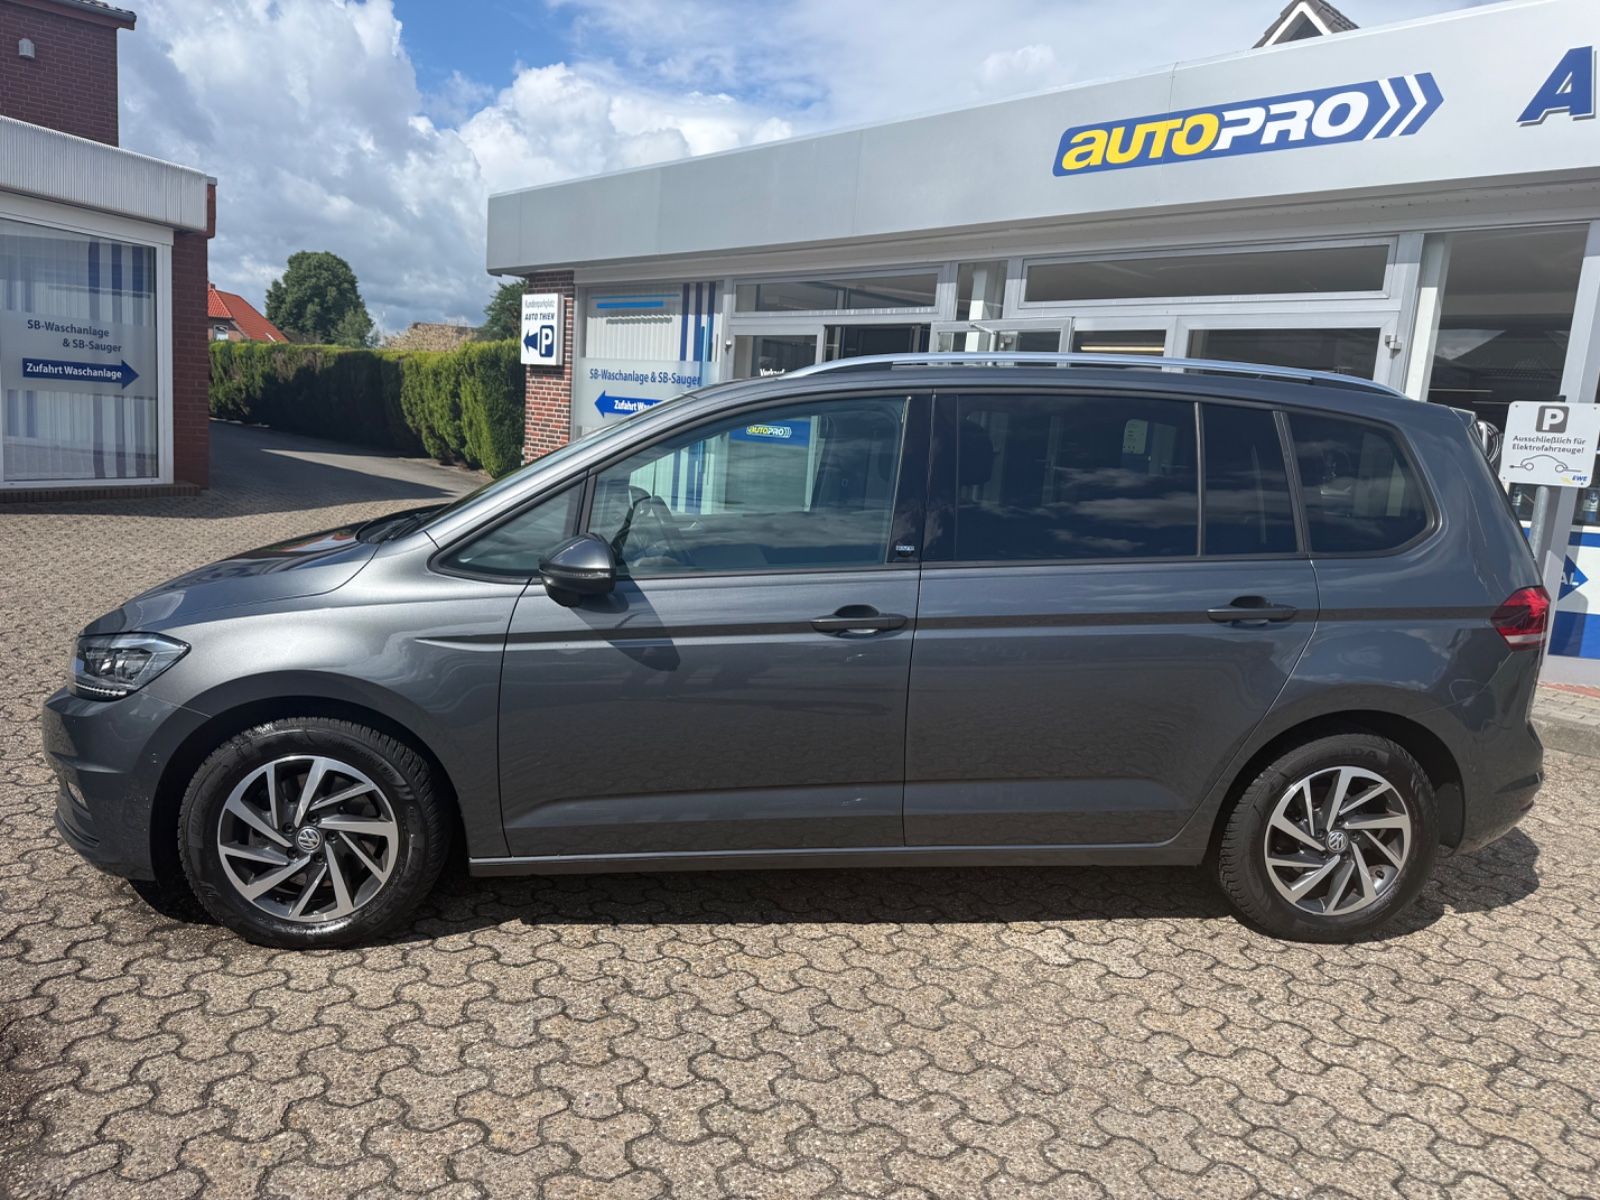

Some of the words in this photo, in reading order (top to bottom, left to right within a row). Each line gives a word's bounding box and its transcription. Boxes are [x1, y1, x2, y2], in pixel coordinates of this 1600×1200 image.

[27, 319, 110, 339] SB-Waschanlage
[62, 337, 70, 348] &
[72, 339, 122, 354] SB-Sauger
[26, 362, 62, 375] Zufahrt
[64, 365, 122, 380] Waschanlage
[590, 368, 649, 385] SB-Waschanlage
[650, 371, 657, 383] &
[658, 371, 702, 389] SB-Sauger
[613, 399, 637, 412] Zufahrt
[1573, 437, 1587, 445] für
